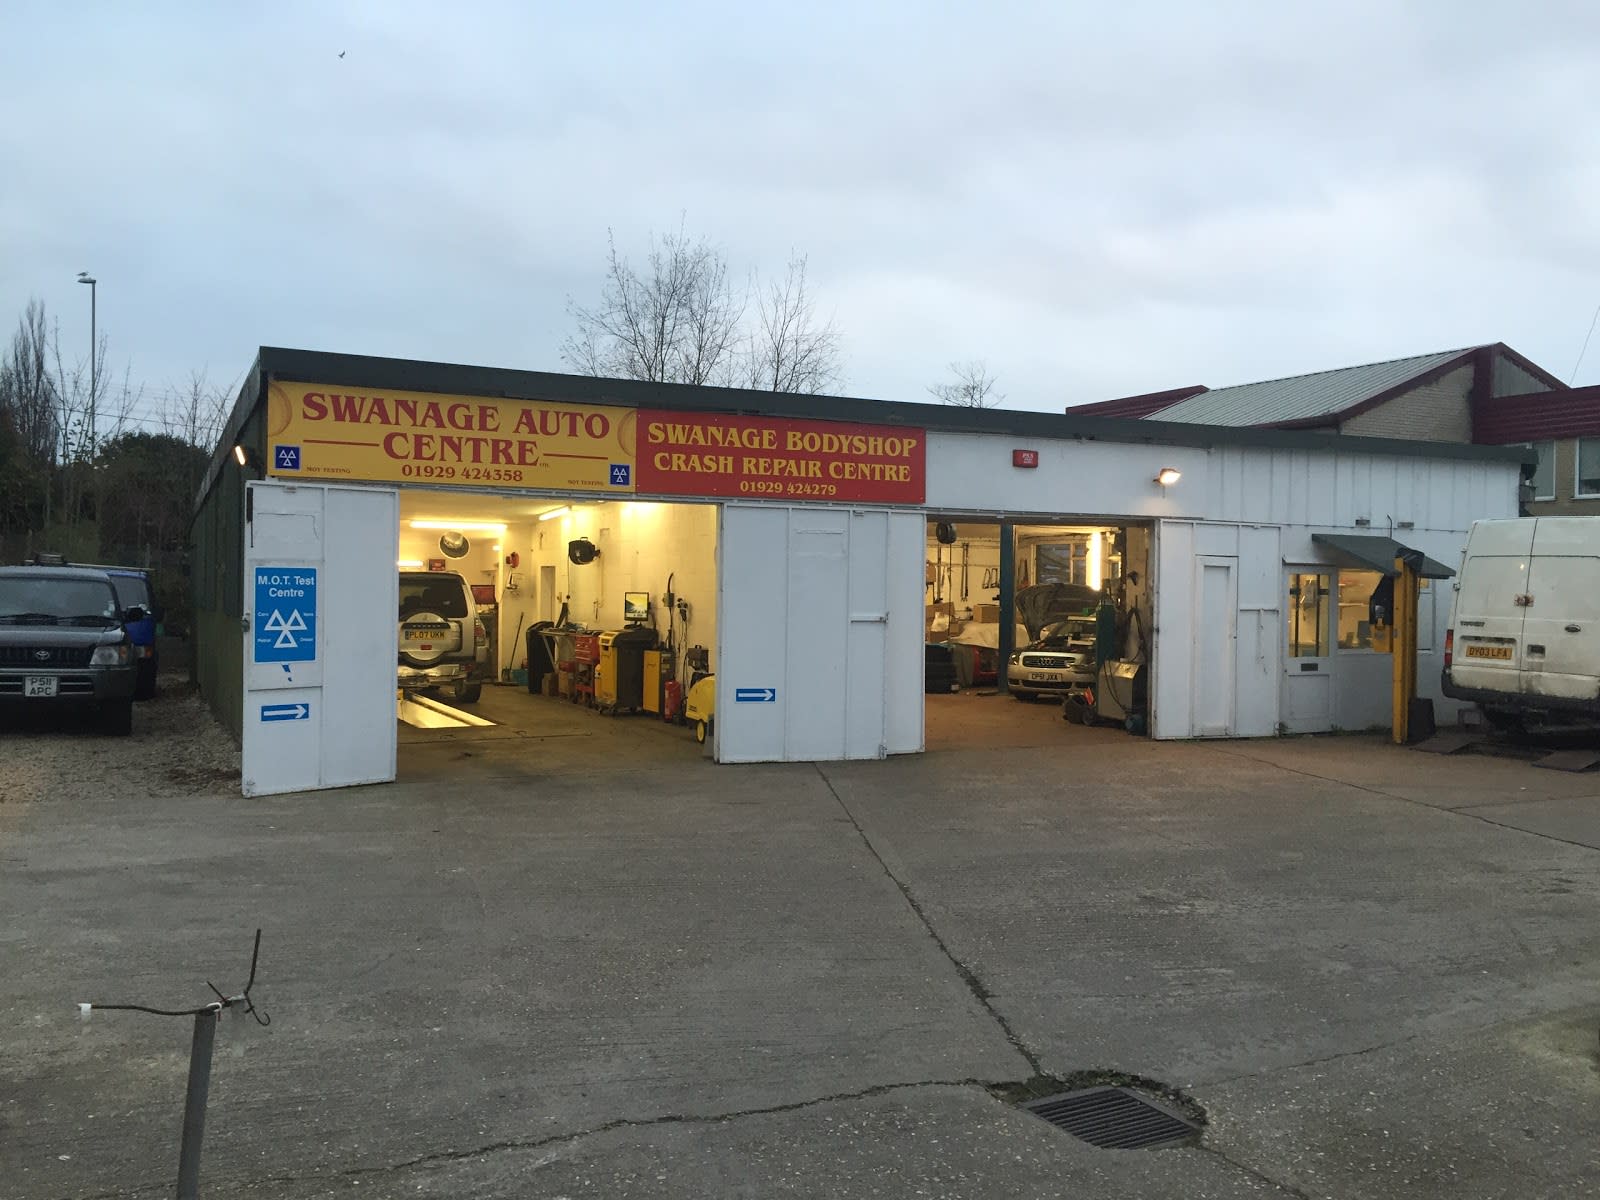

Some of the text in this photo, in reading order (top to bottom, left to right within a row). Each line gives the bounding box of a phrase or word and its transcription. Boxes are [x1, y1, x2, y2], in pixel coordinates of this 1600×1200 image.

[302, 392, 610, 439] SWANAGE AUTO
[648, 422, 917, 457] SWANAGE BODYSHOP
[383, 432, 539, 467] CENTRE
[402, 464, 523, 482] 01929 424358
[654, 452, 911, 482] CRASH REPAIR CENTRE
[740, 481, 837, 496] 01929 424279
[257, 575, 315, 585] M.O.T. Test
[268, 587, 305, 598] Centre
[30, 687, 52, 695] APC
